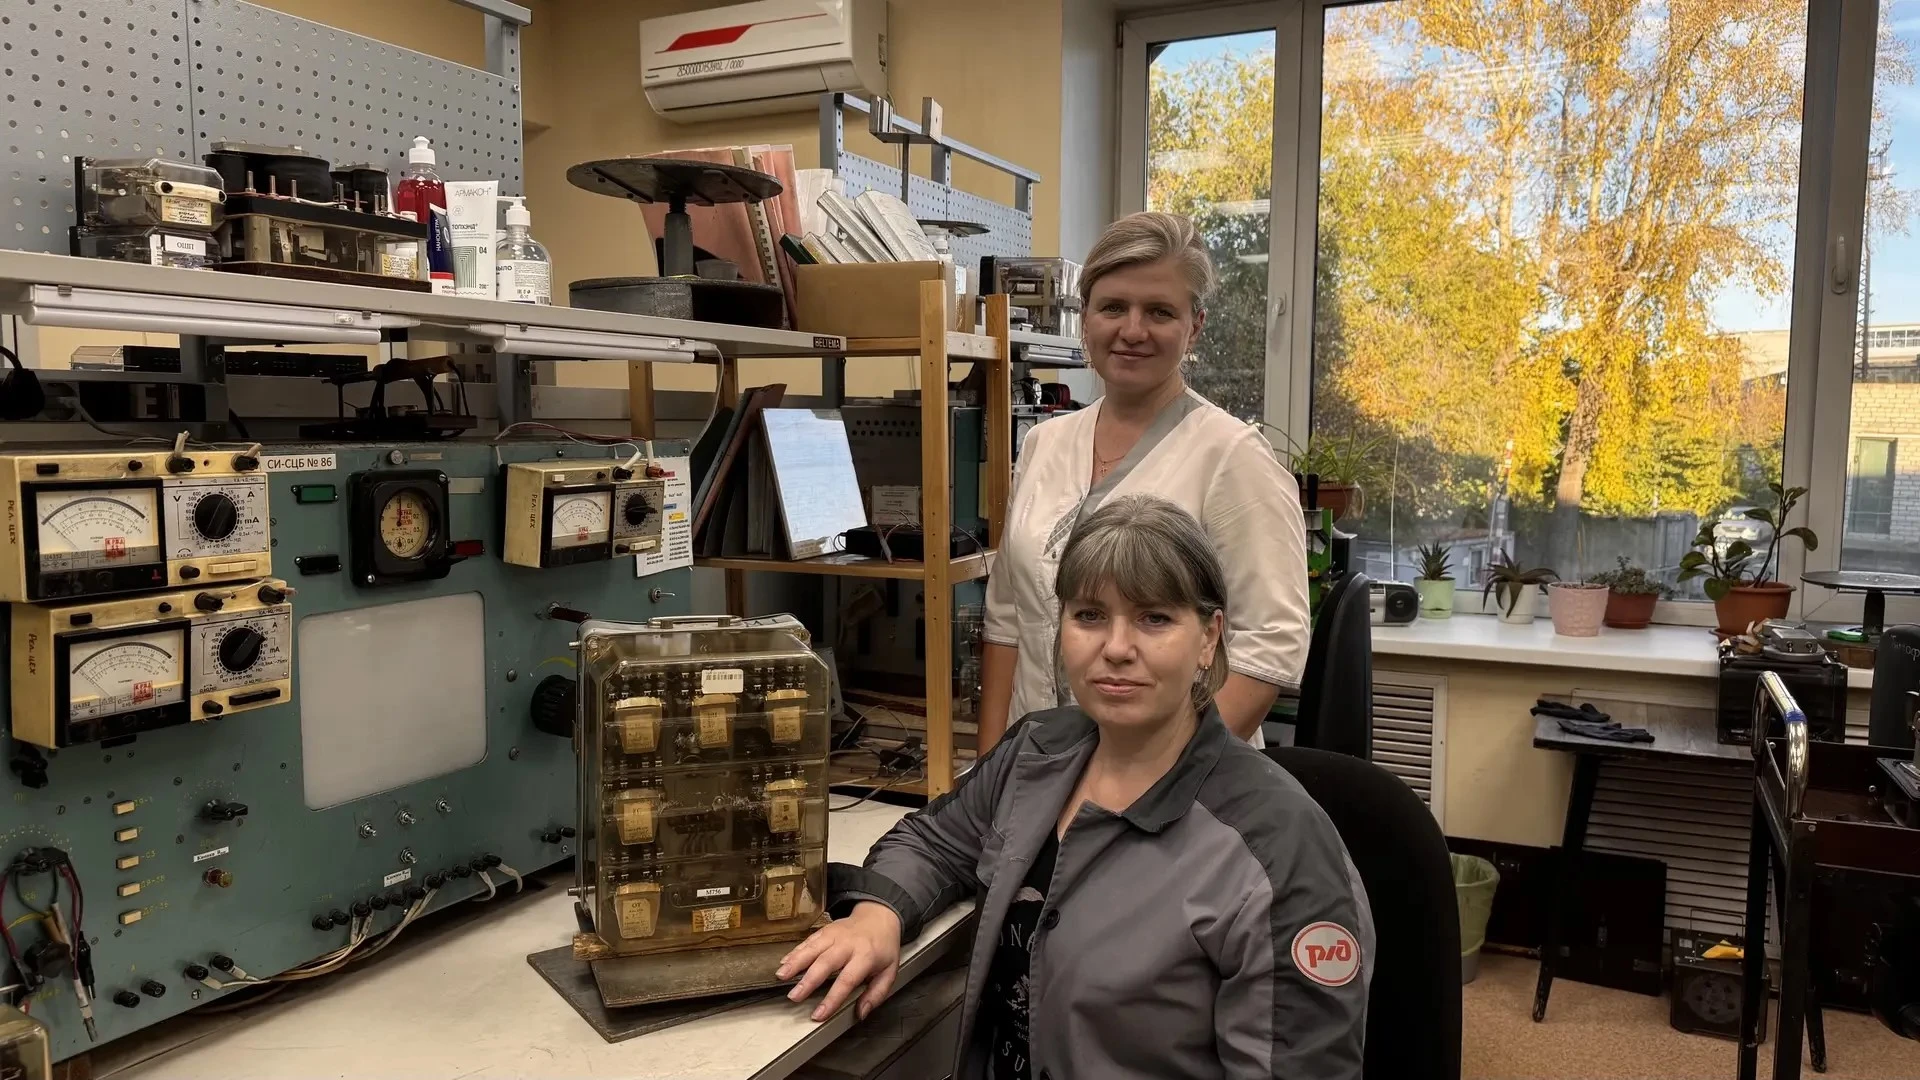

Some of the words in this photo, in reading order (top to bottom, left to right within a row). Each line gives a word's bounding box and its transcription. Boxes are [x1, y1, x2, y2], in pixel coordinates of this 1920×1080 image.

[478, 246, 488, 254] 04
[267, 457, 305, 470] СИ-СЦБ
[320, 457, 332, 467] 86
